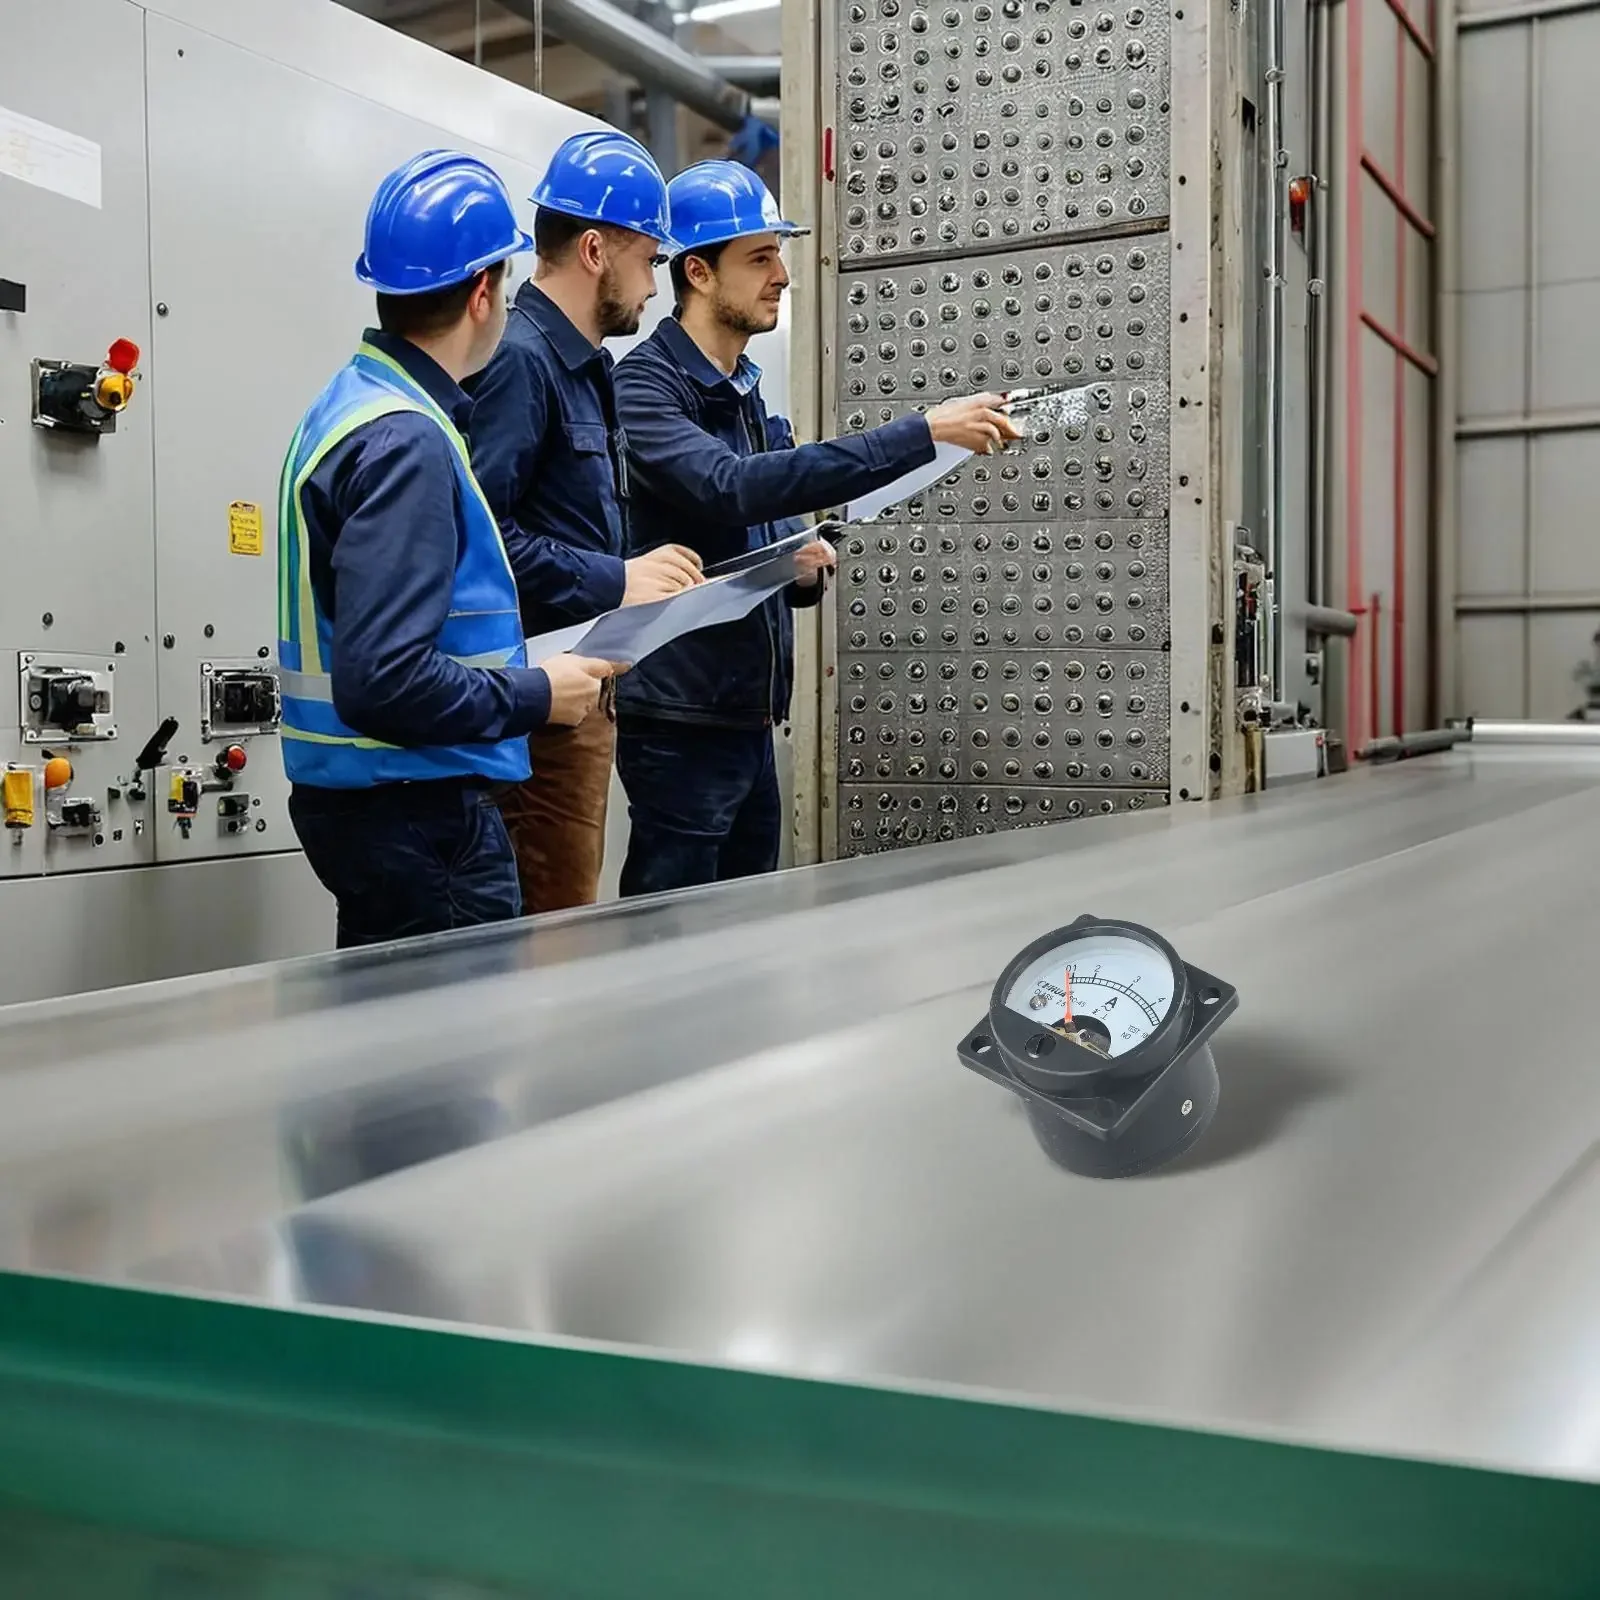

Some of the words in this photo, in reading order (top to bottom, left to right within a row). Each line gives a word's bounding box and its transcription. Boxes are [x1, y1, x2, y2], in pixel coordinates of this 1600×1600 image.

[1094, 964, 1101, 973] 2
[1133, 975, 1142, 983] 3
[1104, 996, 1118, 1009] A
